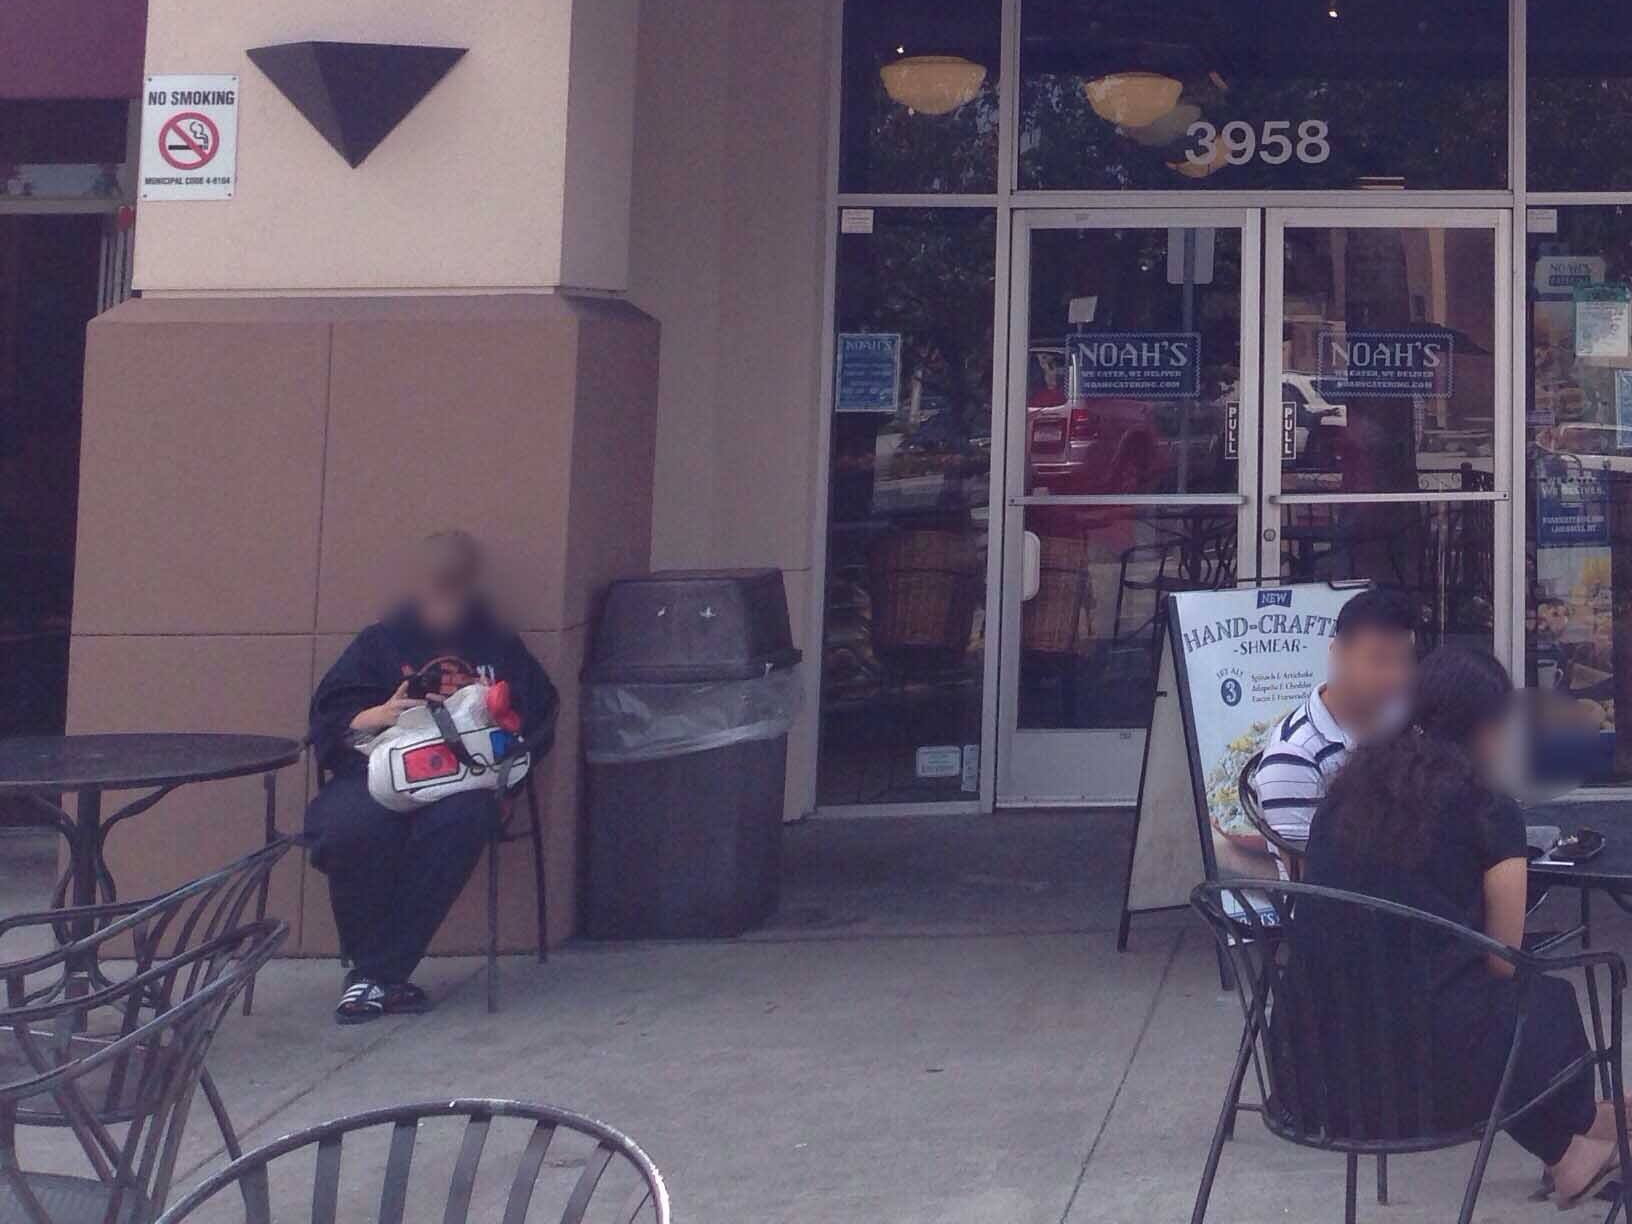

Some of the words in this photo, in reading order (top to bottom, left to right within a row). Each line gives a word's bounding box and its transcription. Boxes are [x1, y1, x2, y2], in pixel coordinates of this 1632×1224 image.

[148, 91, 166, 106] NO
[171, 91, 235, 105] SMOKING
[1185, 120, 1330, 165] 3958
[1078, 341, 1188, 367] NOAH'S
[1331, 342, 1441, 367] NOAH'S
[1229, 407, 1237, 453] PULL
[1284, 407, 1293, 454] PULL
[1261, 592, 1287, 604] NEW
[1225, 680, 1237, 702] 3
